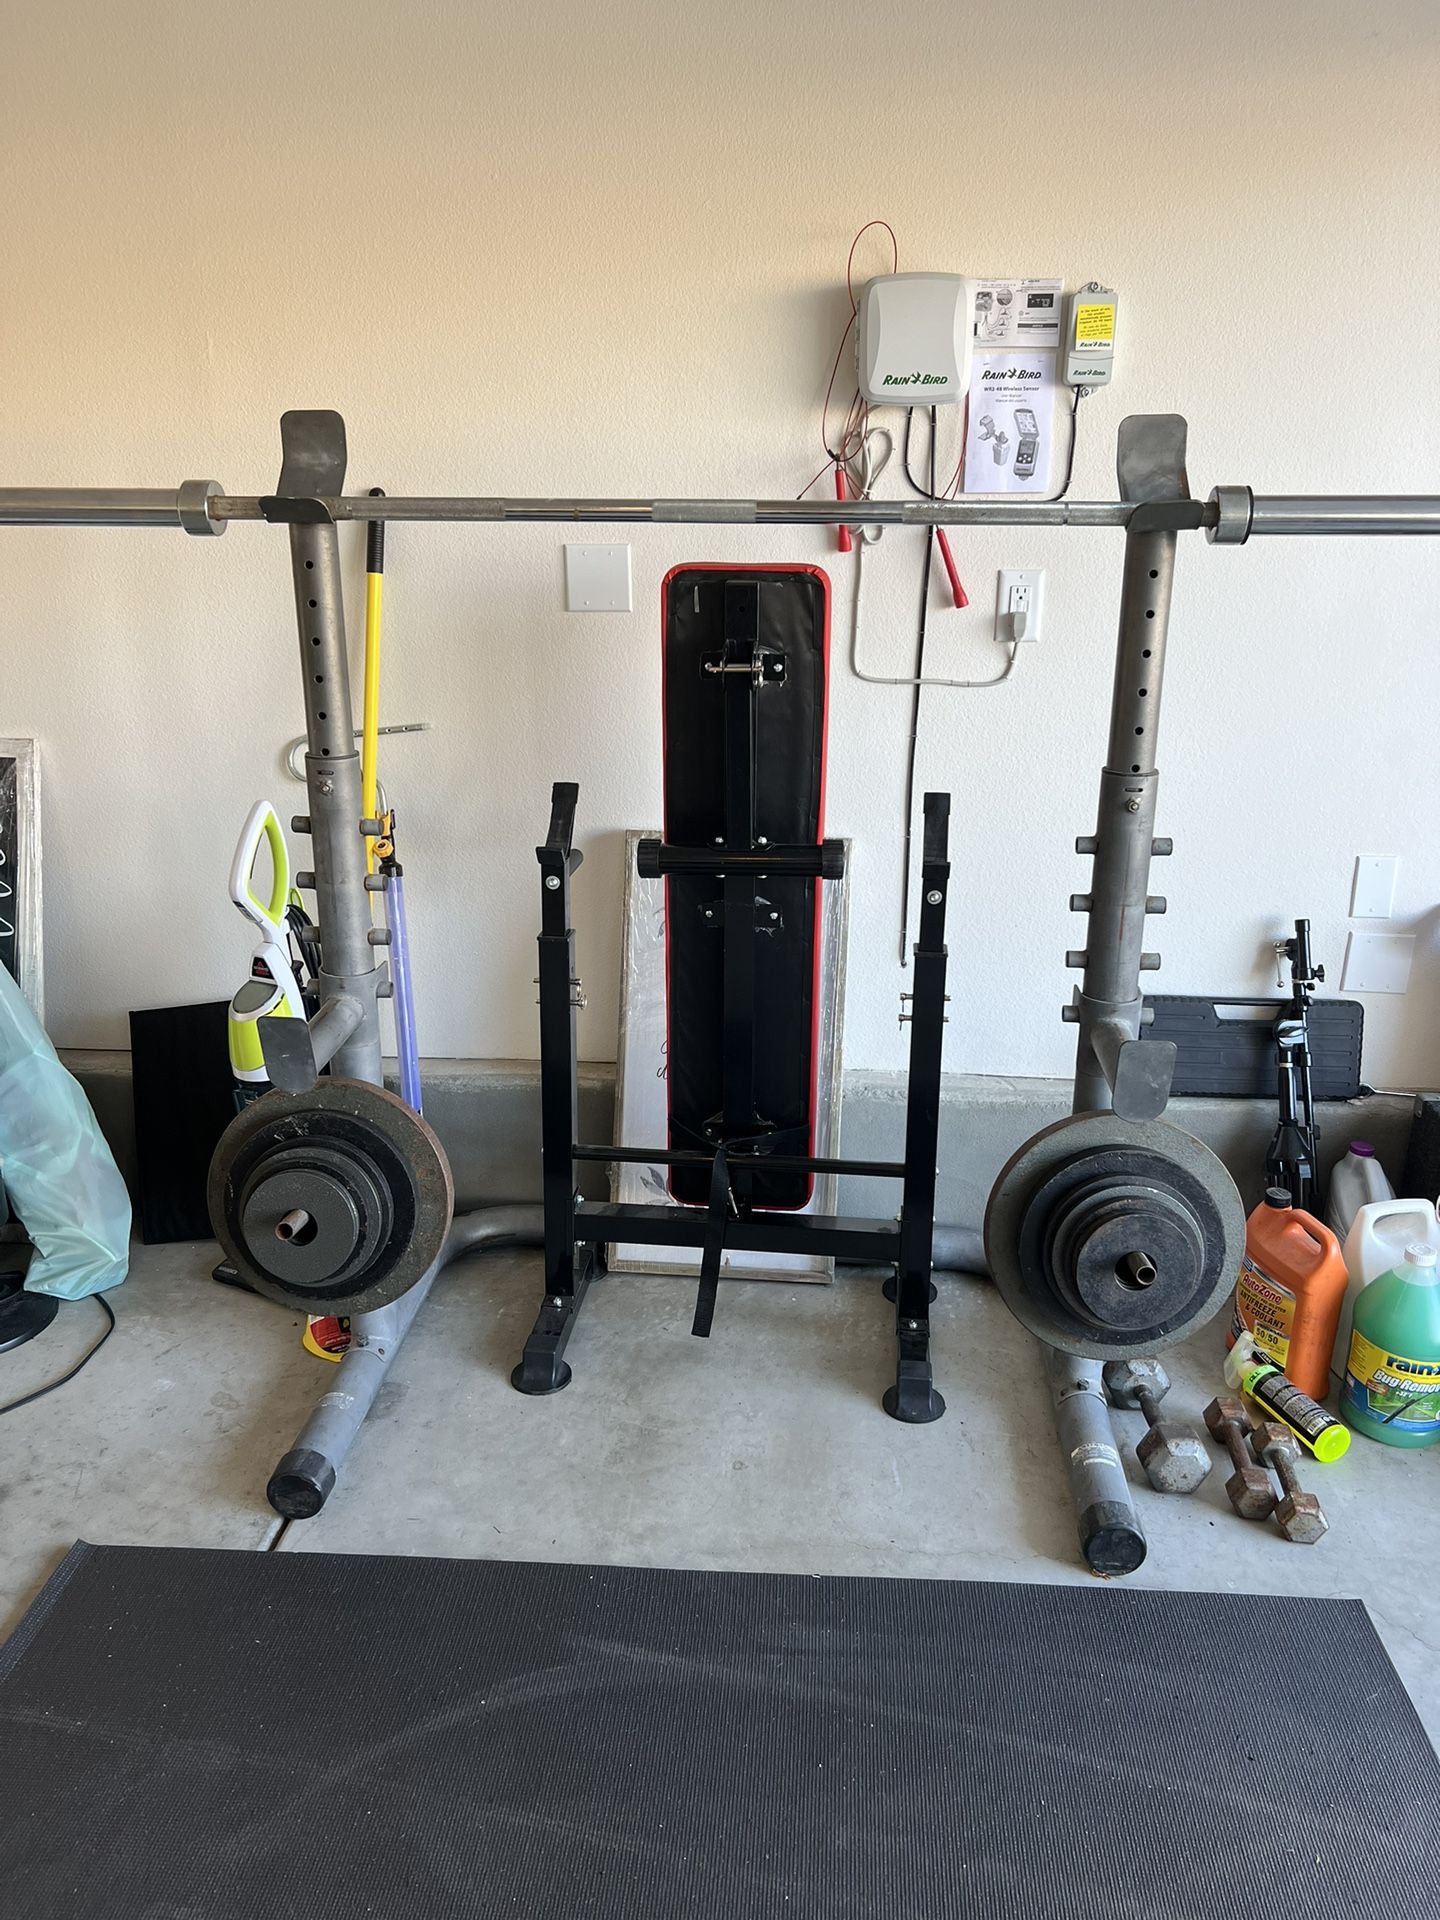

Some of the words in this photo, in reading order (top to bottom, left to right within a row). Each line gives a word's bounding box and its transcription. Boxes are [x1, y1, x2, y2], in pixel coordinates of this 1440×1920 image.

[882, 374, 911, 386] RAIN
[921, 373, 948, 385] BIRD
[981, 370, 1007, 380] RAIN
[1017, 369, 1042, 380] BIRD
[1242, 1273, 1283, 1304] AutoZone
[1240, 1290, 1277, 1317] ANTIFREEZE
[1250, 1307, 1286, 1329] COOLANT
[1255, 1327, 1279, 1345] 50/50
[1373, 1369, 1400, 1388] Bug
